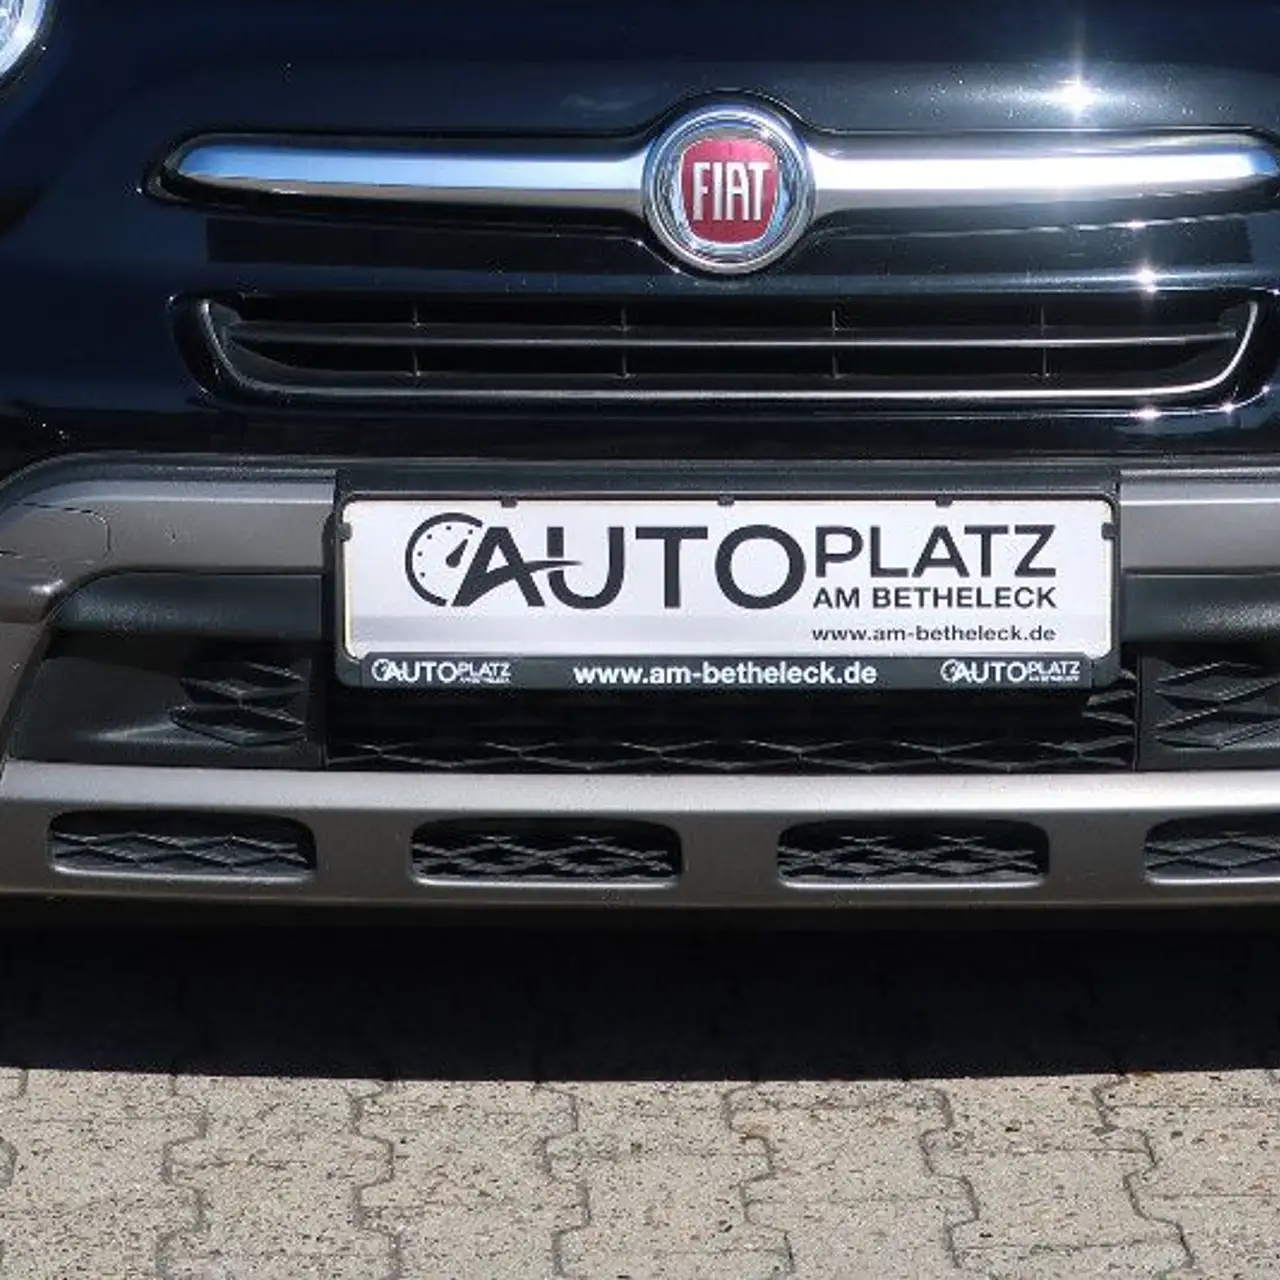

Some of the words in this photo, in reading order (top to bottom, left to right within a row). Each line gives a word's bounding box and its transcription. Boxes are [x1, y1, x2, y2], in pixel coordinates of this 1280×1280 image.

[692, 161, 771, 221] FIAT
[812, 586, 861, 609] AM
[872, 586, 1057, 609] BETHELECK
[812, 624, 1057, 642] www.am-betheleck.de
[572, 661, 878, 685] www.am-betheleck.de
